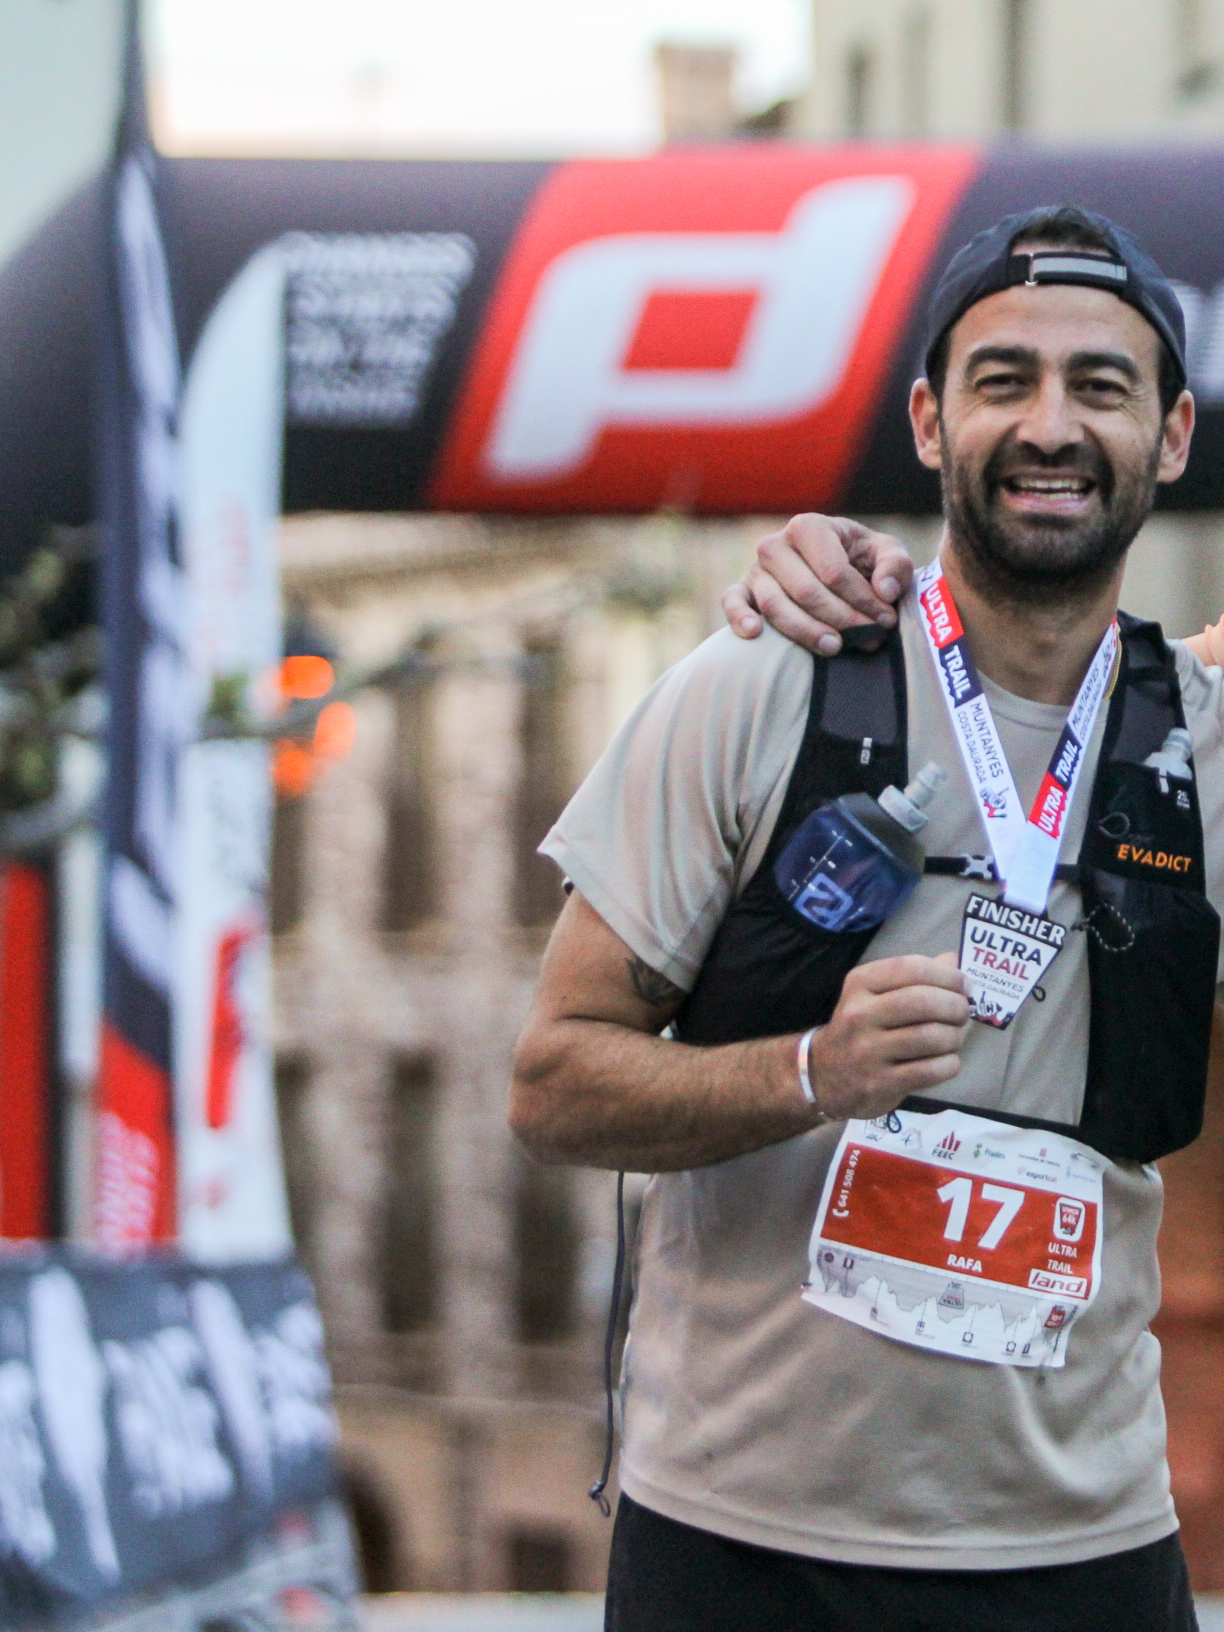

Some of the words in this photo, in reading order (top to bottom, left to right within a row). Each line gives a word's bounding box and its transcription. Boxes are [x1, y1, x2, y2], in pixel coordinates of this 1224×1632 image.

[925, 583, 952, 643] ULTRA
[944, 645, 973, 700] TRAIL
[957, 710, 972, 740] COSTA
[966, 738, 988, 784] DAURADA
[969, 701, 1004, 778] MUNTANYES
[1038, 785, 1064, 833] ULTRA
[1055, 739, 1078, 783] TRAIL
[1116, 843, 1192, 872] EVADICT
[966, 894, 1066, 946] FINISHER
[970, 926, 1042, 966] ULTRA
[972, 946, 1030, 981] TRAIL
[966, 967, 1026, 993] MUNTANYES
[931, 1148, 955, 1161] FEEC
[842, 1168, 855, 1187] 508
[837, 1189, 850, 1208] 641
[936, 1175, 1025, 1250] 17
[946, 1254, 983, 1274] RAFA
[1047, 1242, 1078, 1258] ULTRA
[1047, 1259, 1074, 1275] TRAIL
[1031, 1271, 1085, 1293] land
